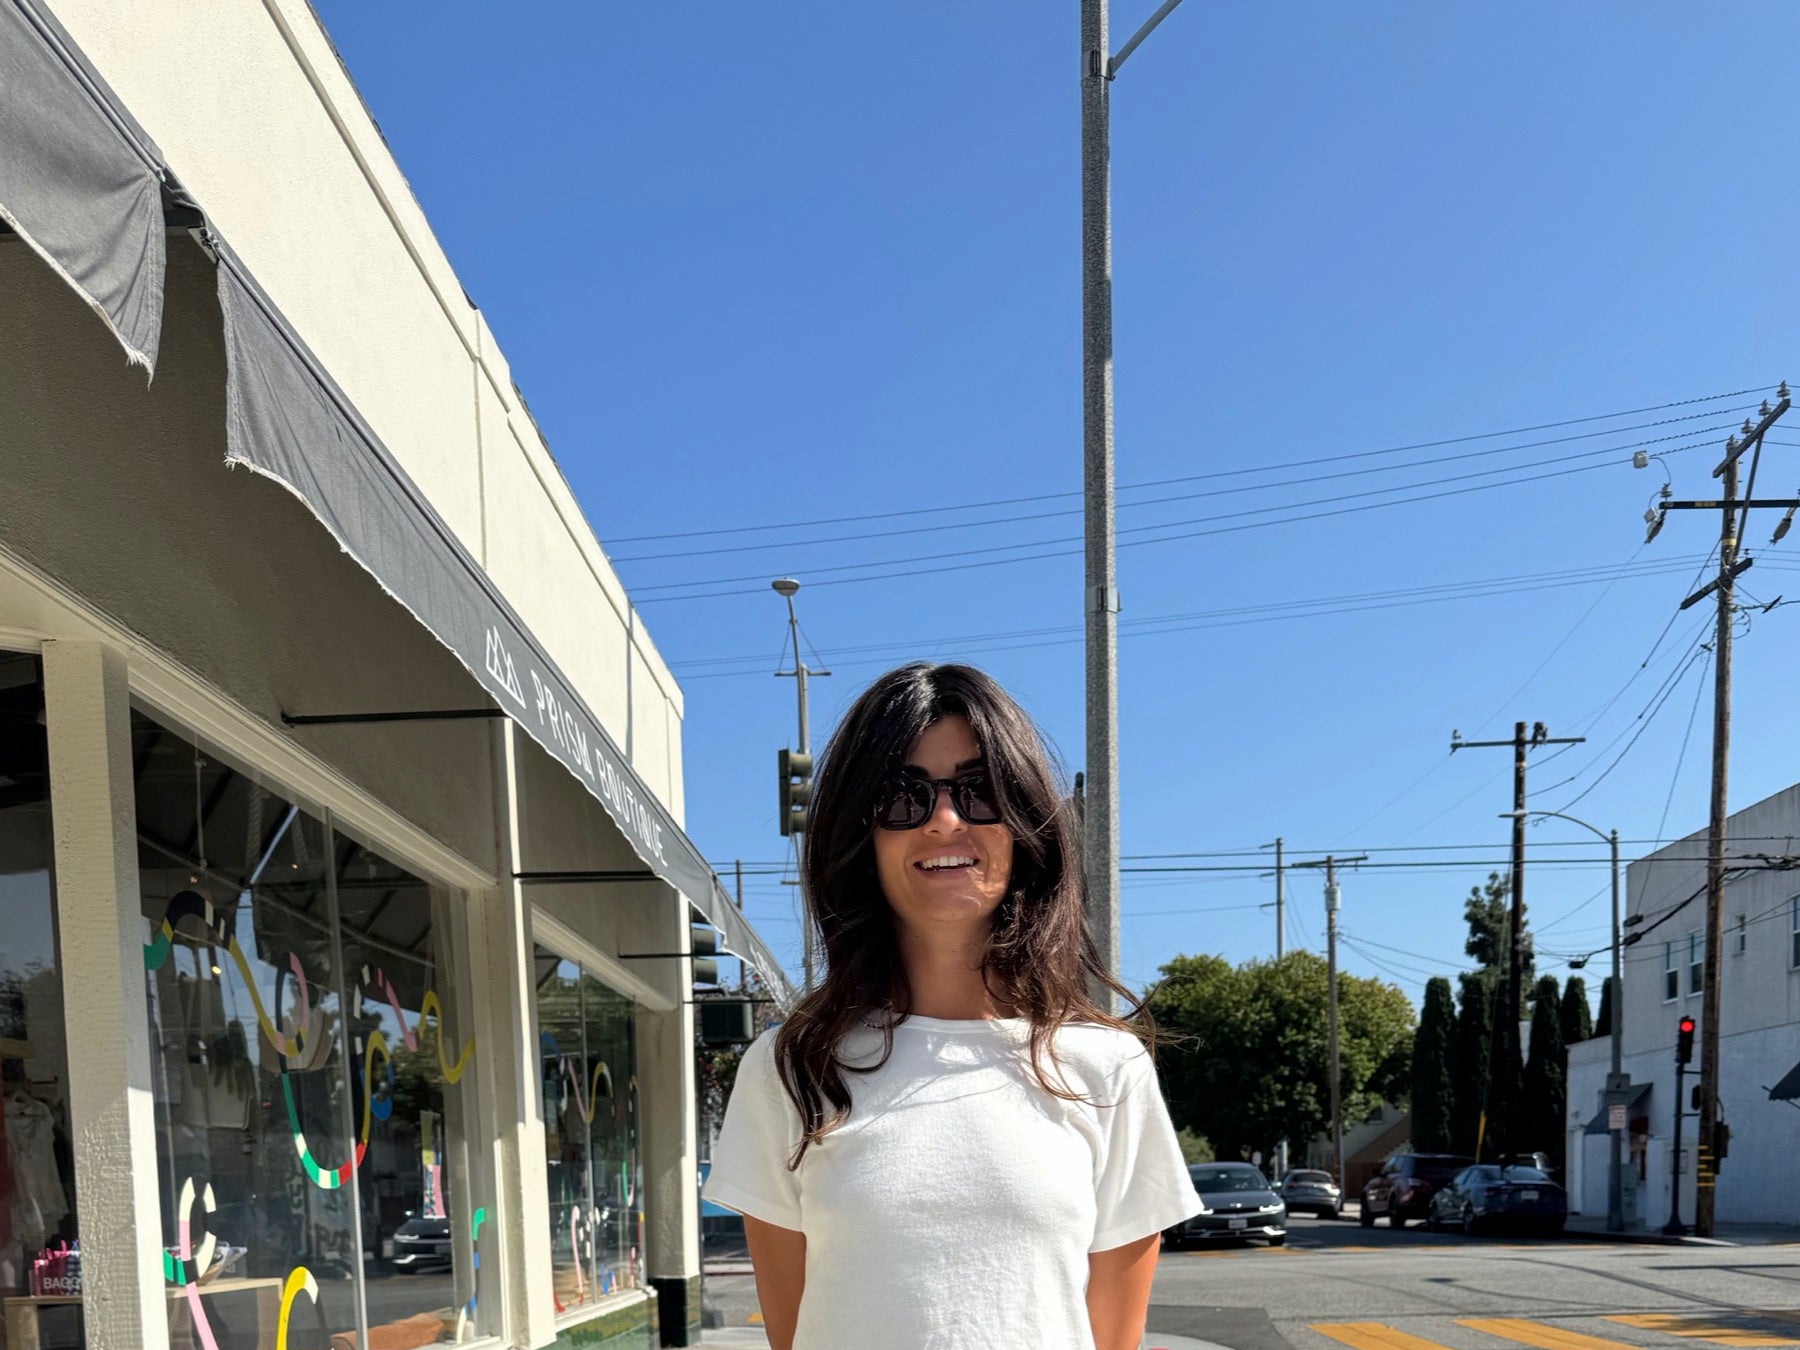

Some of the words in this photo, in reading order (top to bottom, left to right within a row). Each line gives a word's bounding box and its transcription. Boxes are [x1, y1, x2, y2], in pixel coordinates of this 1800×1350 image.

[530, 669, 596, 783] PRISM
[595, 747, 669, 868] BOUTIQUE
[43, 1276, 81, 1290] BAGG
